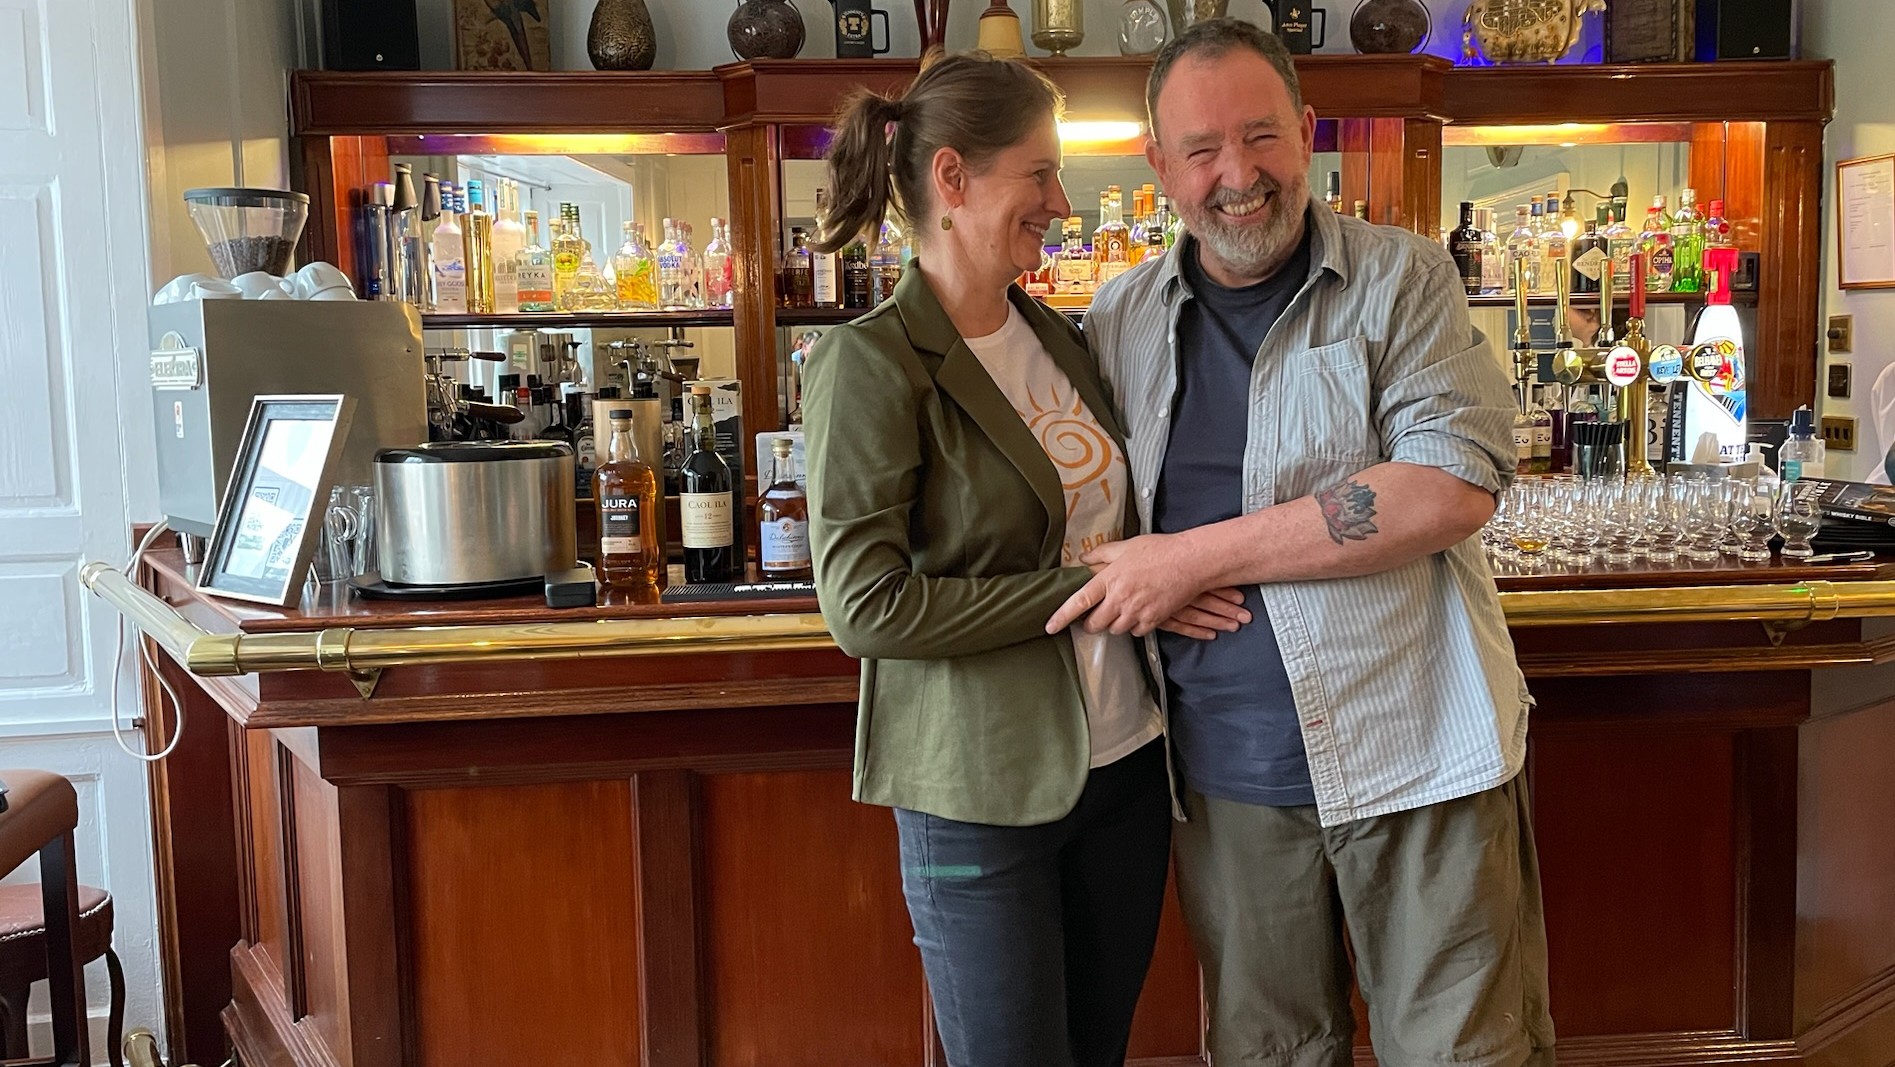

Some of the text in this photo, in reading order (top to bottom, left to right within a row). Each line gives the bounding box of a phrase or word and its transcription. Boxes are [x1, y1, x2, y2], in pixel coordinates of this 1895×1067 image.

[659, 261, 681, 269] VODKA
[1719, 445, 1734, 455] AT
[601, 499, 637, 509] JURA
[704, 512, 713, 520] 12
[1831, 511, 1855, 519] WHISKY
[1855, 514, 1873, 522] BIBLE
